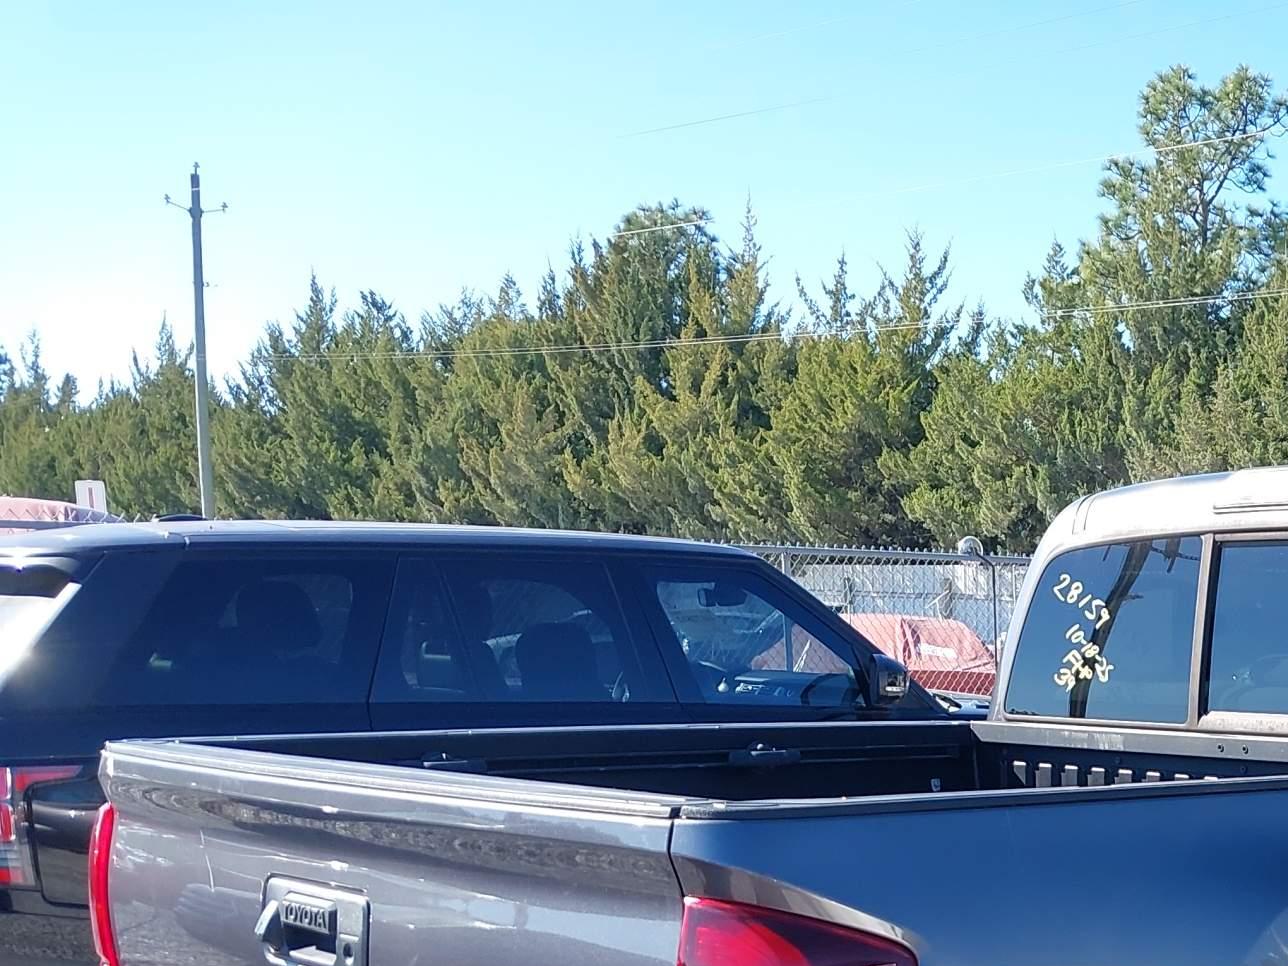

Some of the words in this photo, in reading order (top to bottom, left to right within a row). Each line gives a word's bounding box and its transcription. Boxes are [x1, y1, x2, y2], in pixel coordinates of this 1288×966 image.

[1053, 573, 1111, 630] 28159
[1065, 624, 1114, 682] 10-18-25
[282, 901, 327, 929] TOYOTA
